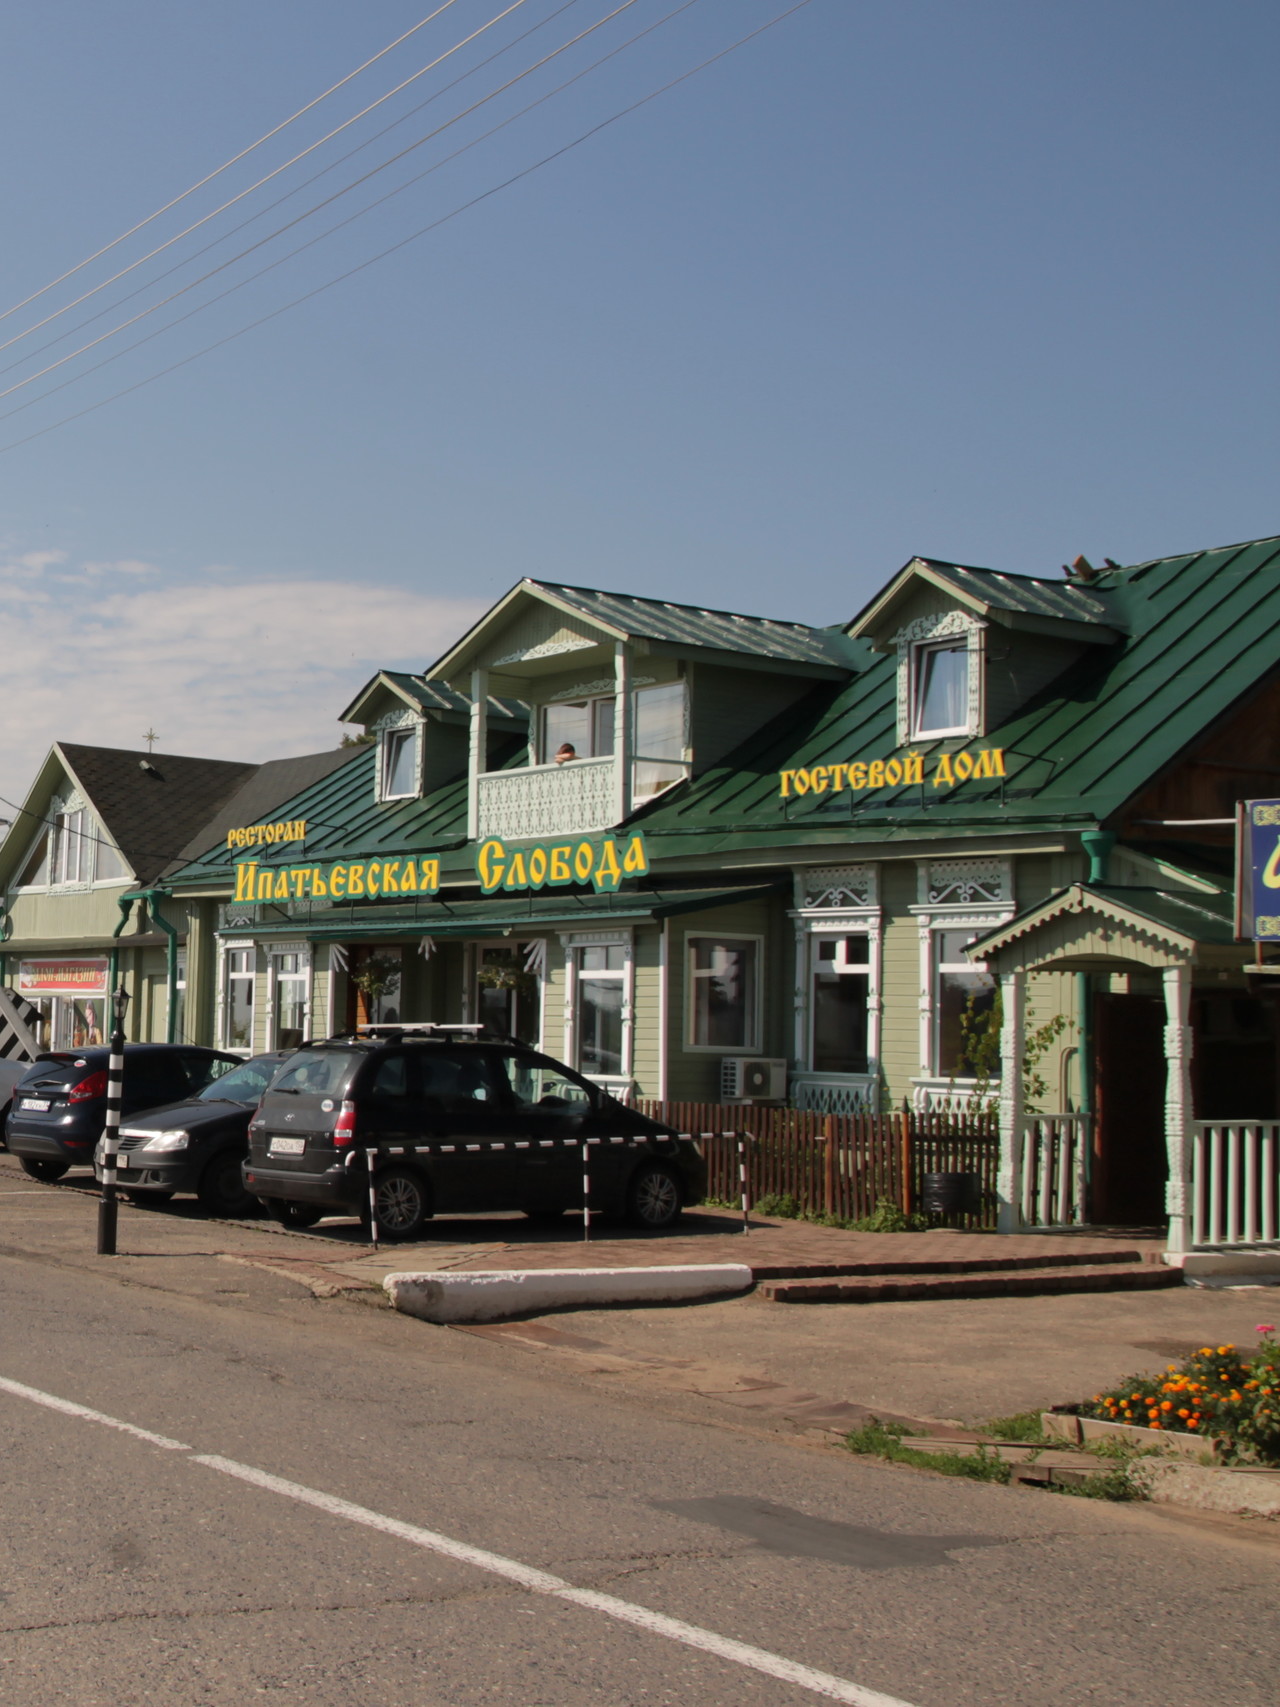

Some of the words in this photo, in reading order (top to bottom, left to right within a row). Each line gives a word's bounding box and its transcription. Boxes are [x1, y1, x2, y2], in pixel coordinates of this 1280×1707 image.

[779, 750, 924, 797] ГОСТЕВОЙ
[933, 748, 1007, 788] ДОМ
[227, 820, 307, 849] РЕСТОРАН
